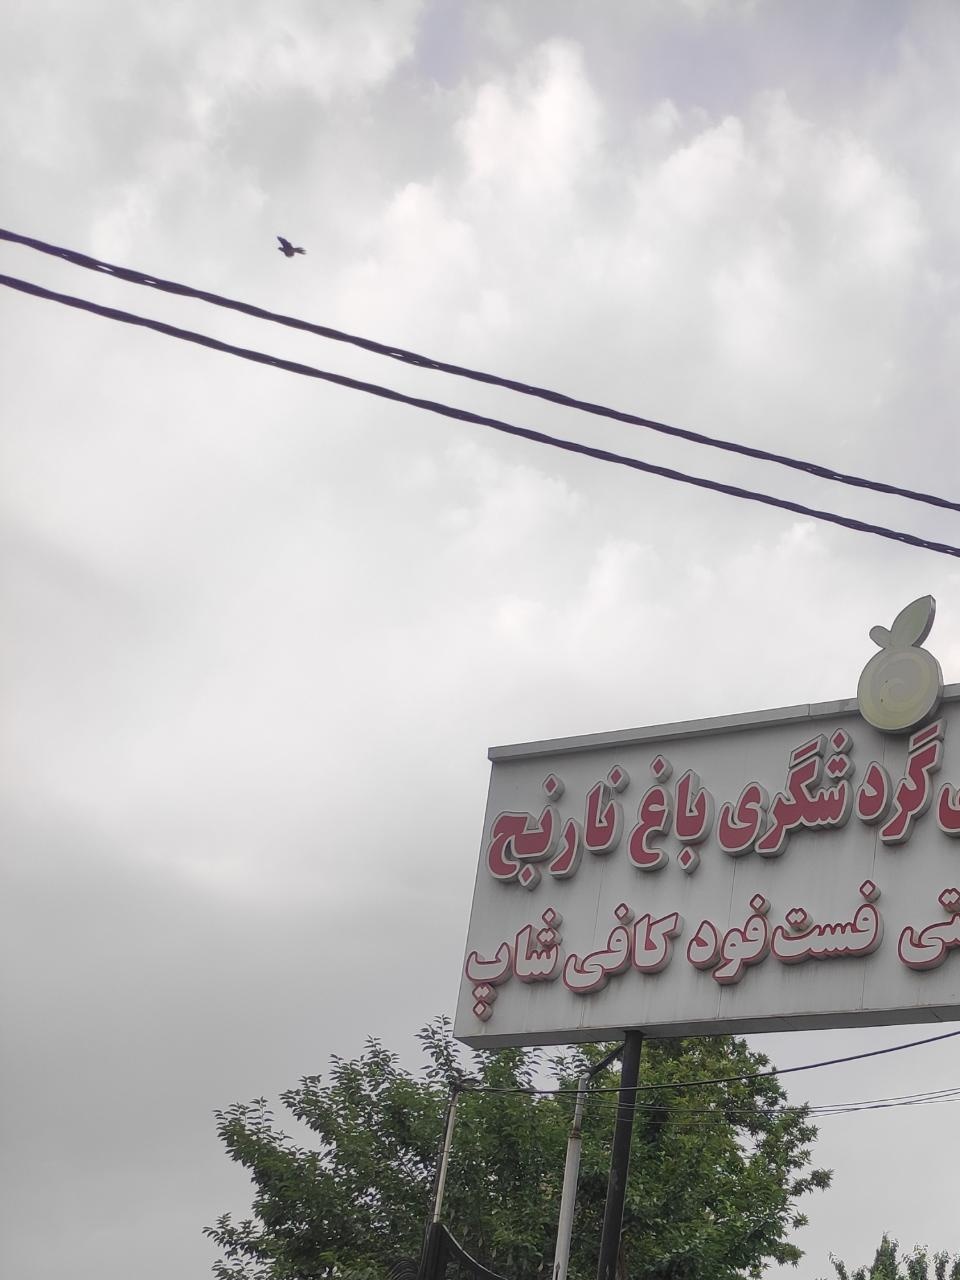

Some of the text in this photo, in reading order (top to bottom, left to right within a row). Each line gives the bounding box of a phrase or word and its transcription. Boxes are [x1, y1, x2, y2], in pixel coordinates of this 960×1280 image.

[487, 764, 629, 889] نارنج
[629, 755, 714, 872] باغ
[717, 719, 947, 857] گردشگری
[465, 908, 562, 1021] شاپ
[563, 903, 684, 993] کافی
[687, 894, 771, 986] فود
[772, 880, 883, 965] فست
